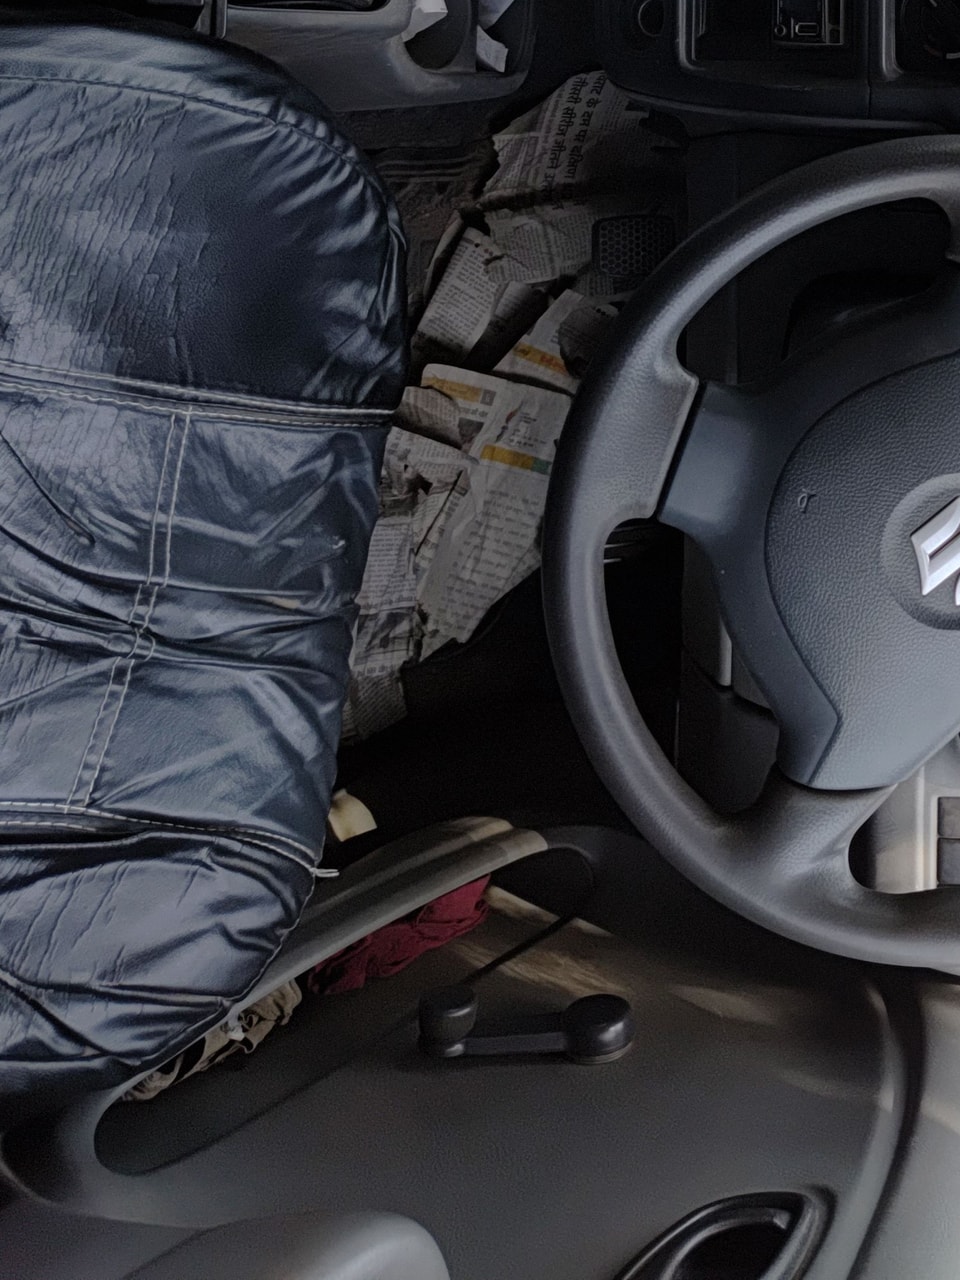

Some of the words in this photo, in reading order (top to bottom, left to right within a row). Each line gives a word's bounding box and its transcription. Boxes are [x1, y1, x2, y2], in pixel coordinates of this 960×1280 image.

[567, 77, 588, 104] तीसरी
[586, 97, 602, 108] के
[556, 106, 576, 136] सीरीज
[579, 111, 594, 126] दम
[574, 129, 588, 142] पर
[546, 139, 565, 169] जीतने
[564, 145, 583, 179] दक्षिण
